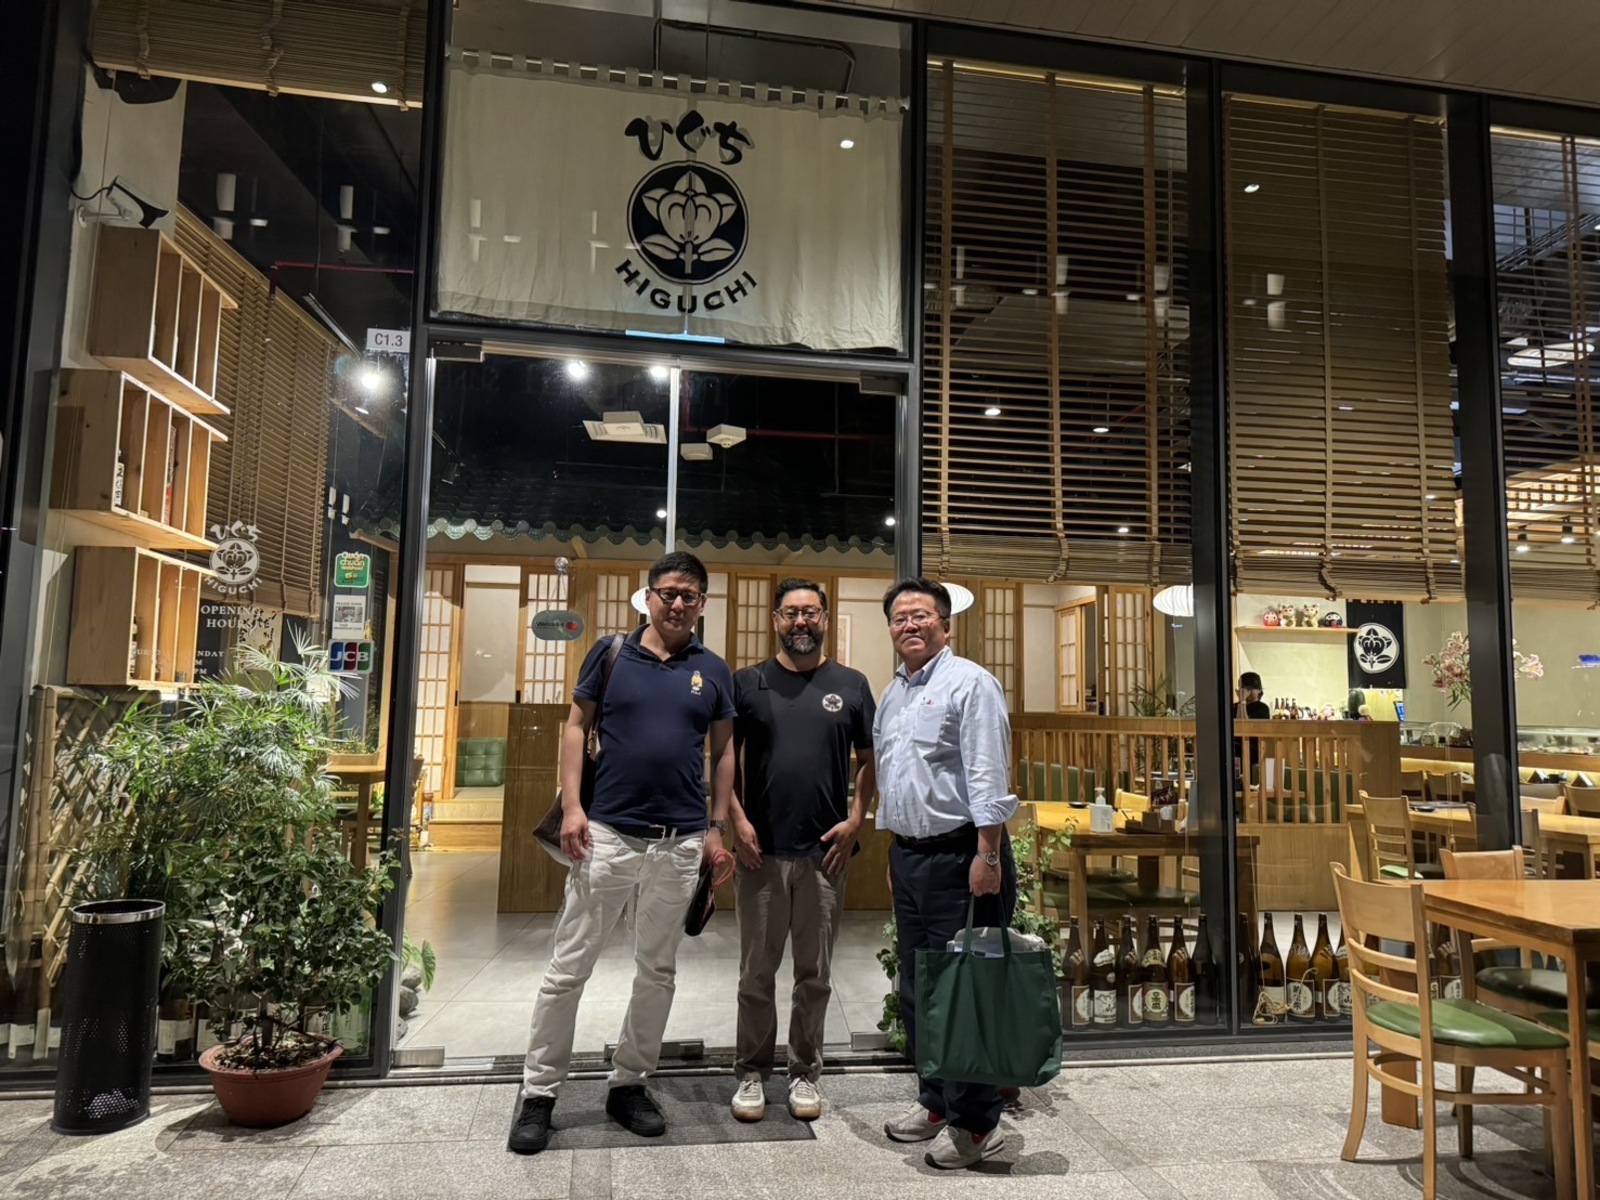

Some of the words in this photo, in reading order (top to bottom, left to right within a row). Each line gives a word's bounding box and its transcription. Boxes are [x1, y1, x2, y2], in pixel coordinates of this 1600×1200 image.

[625, 110, 751, 165] ひぐち
[615, 258, 757, 314] HIGUCHI
[375, 333, 403, 347] C1.3
[210, 520, 263, 541] ひぐち
[205, 577, 263, 595] HIGUCHI
[200, 605, 260, 616] OPENING
[330, 651, 369, 662] JCB
